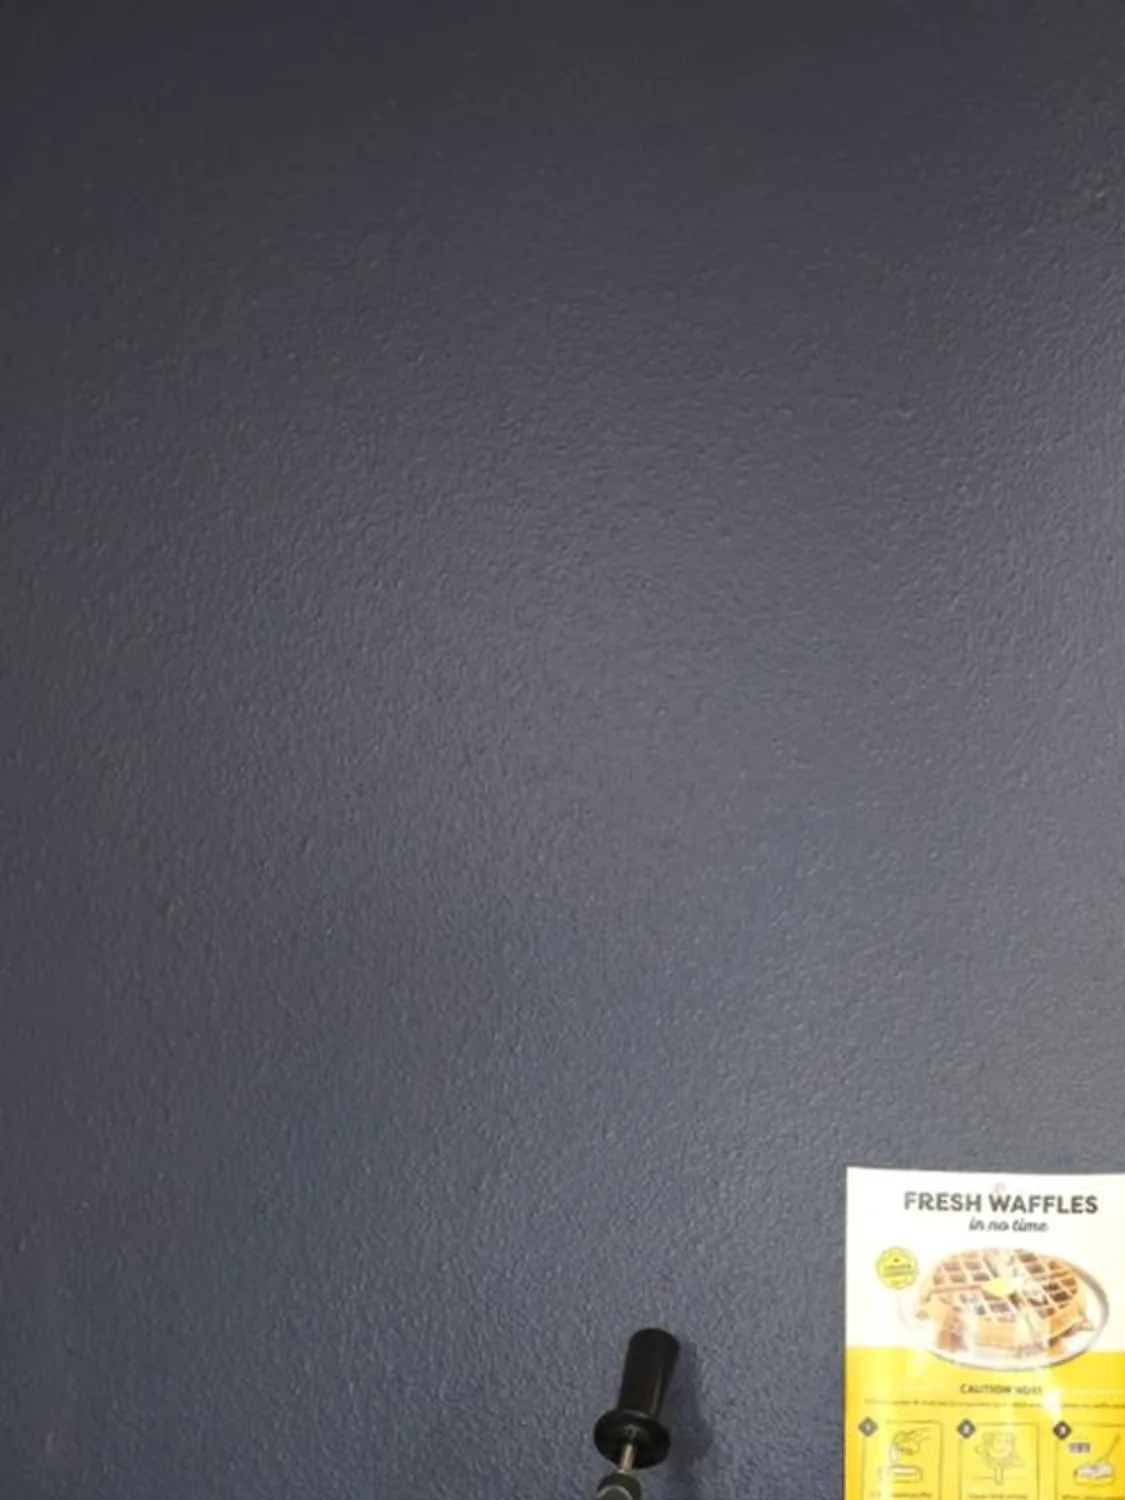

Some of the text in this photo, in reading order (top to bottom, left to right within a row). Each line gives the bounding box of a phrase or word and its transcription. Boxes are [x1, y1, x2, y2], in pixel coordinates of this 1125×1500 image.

[904, 1191, 1099, 1214] FRESH WAFFLES
[968, 1216, 1049, 1233] in no time
